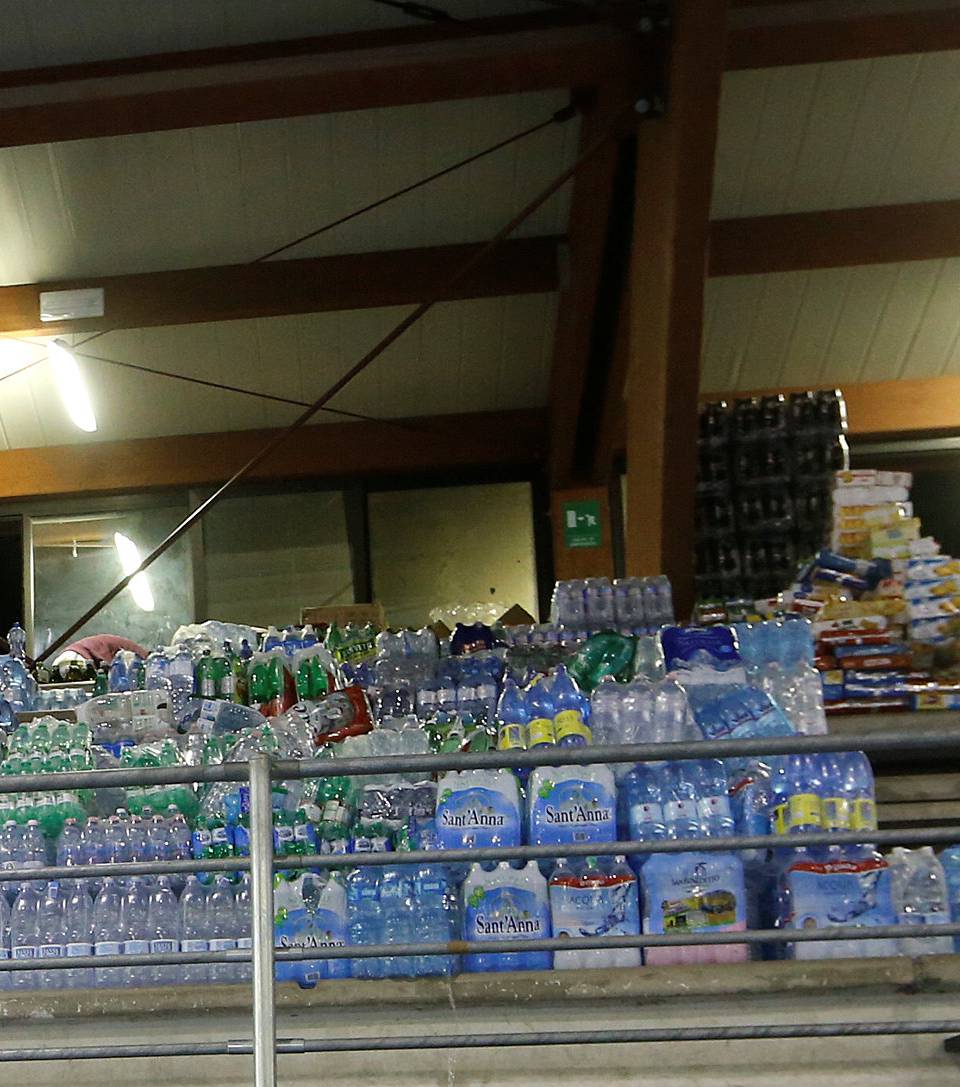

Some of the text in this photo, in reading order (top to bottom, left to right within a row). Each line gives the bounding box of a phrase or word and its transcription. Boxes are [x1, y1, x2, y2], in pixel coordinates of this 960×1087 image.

[442, 808, 504, 827] Sant'Anna
[546, 805, 609, 824] Sant'Anna
[476, 914, 540, 934] Sant'Anna
